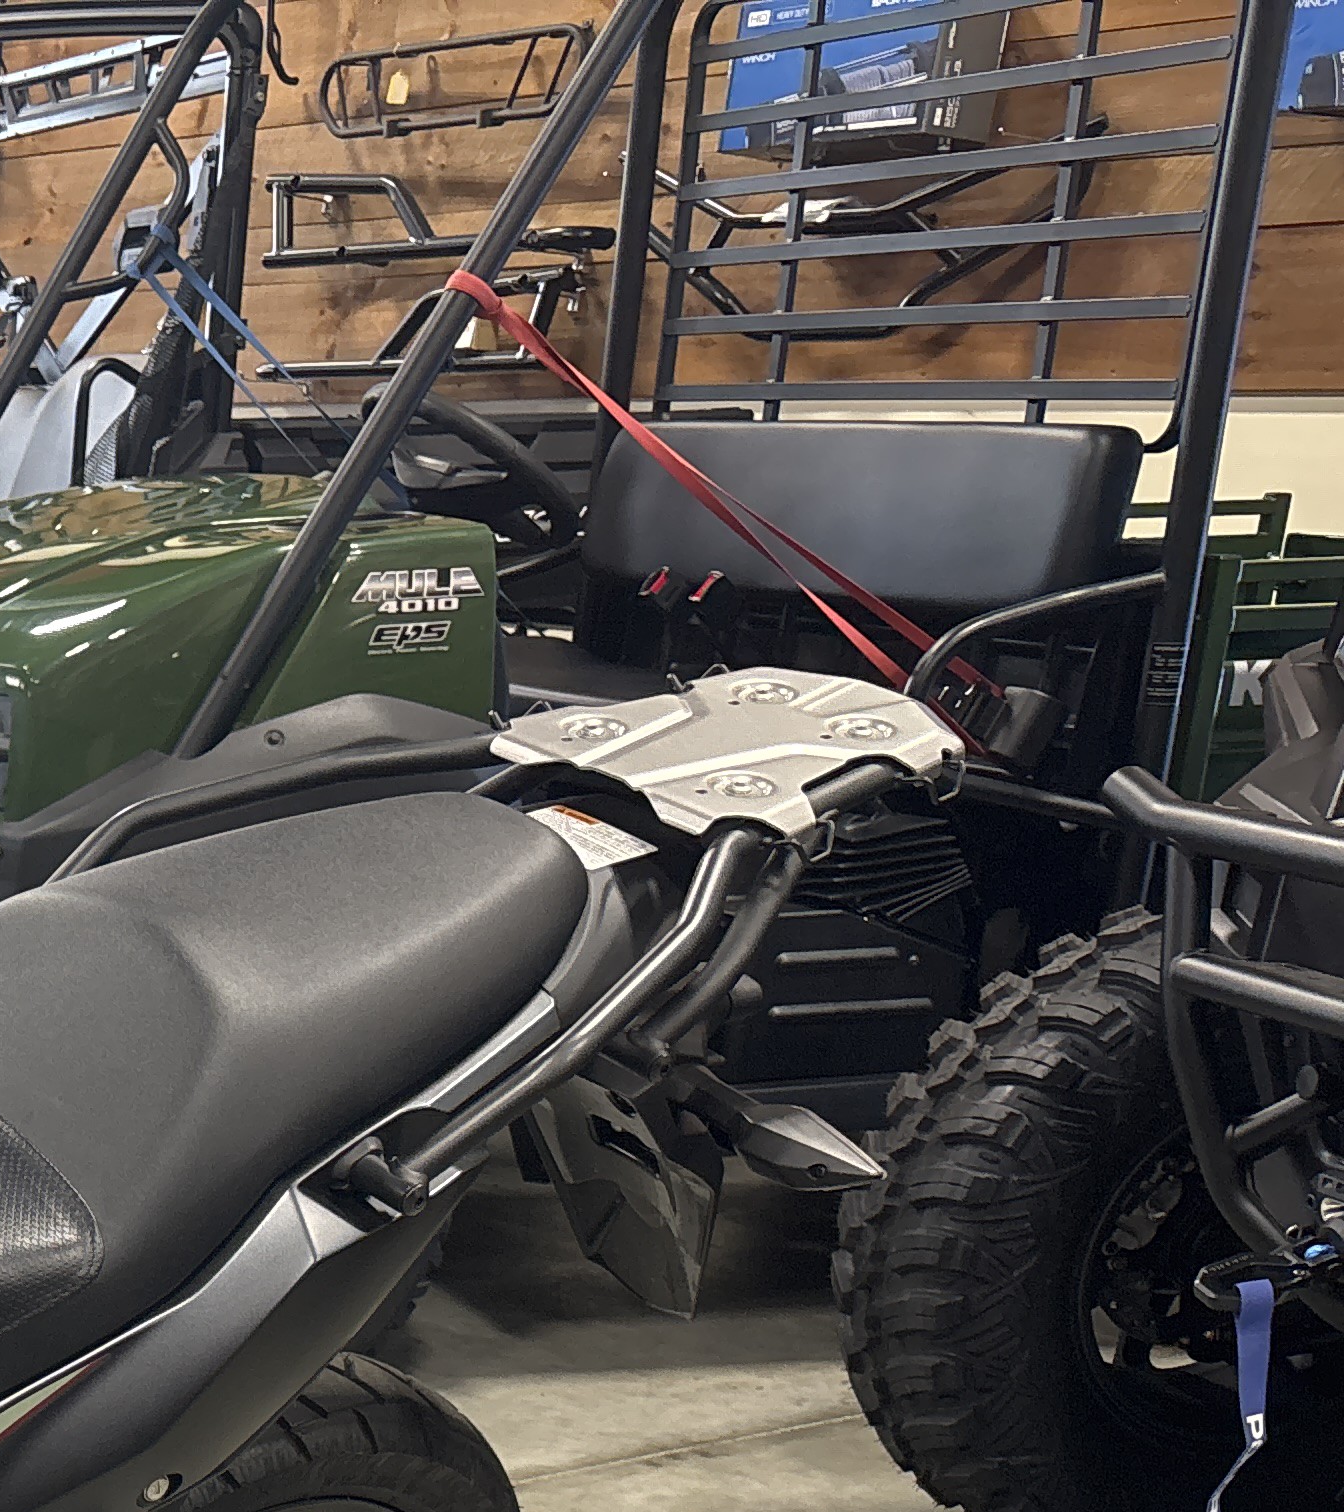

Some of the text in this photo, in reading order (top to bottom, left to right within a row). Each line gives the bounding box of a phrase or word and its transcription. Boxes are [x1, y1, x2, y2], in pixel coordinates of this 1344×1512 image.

[351, 566, 485, 603] MULE
[377, 597, 459, 614] 4010
[369, 620, 452, 650] EPS
